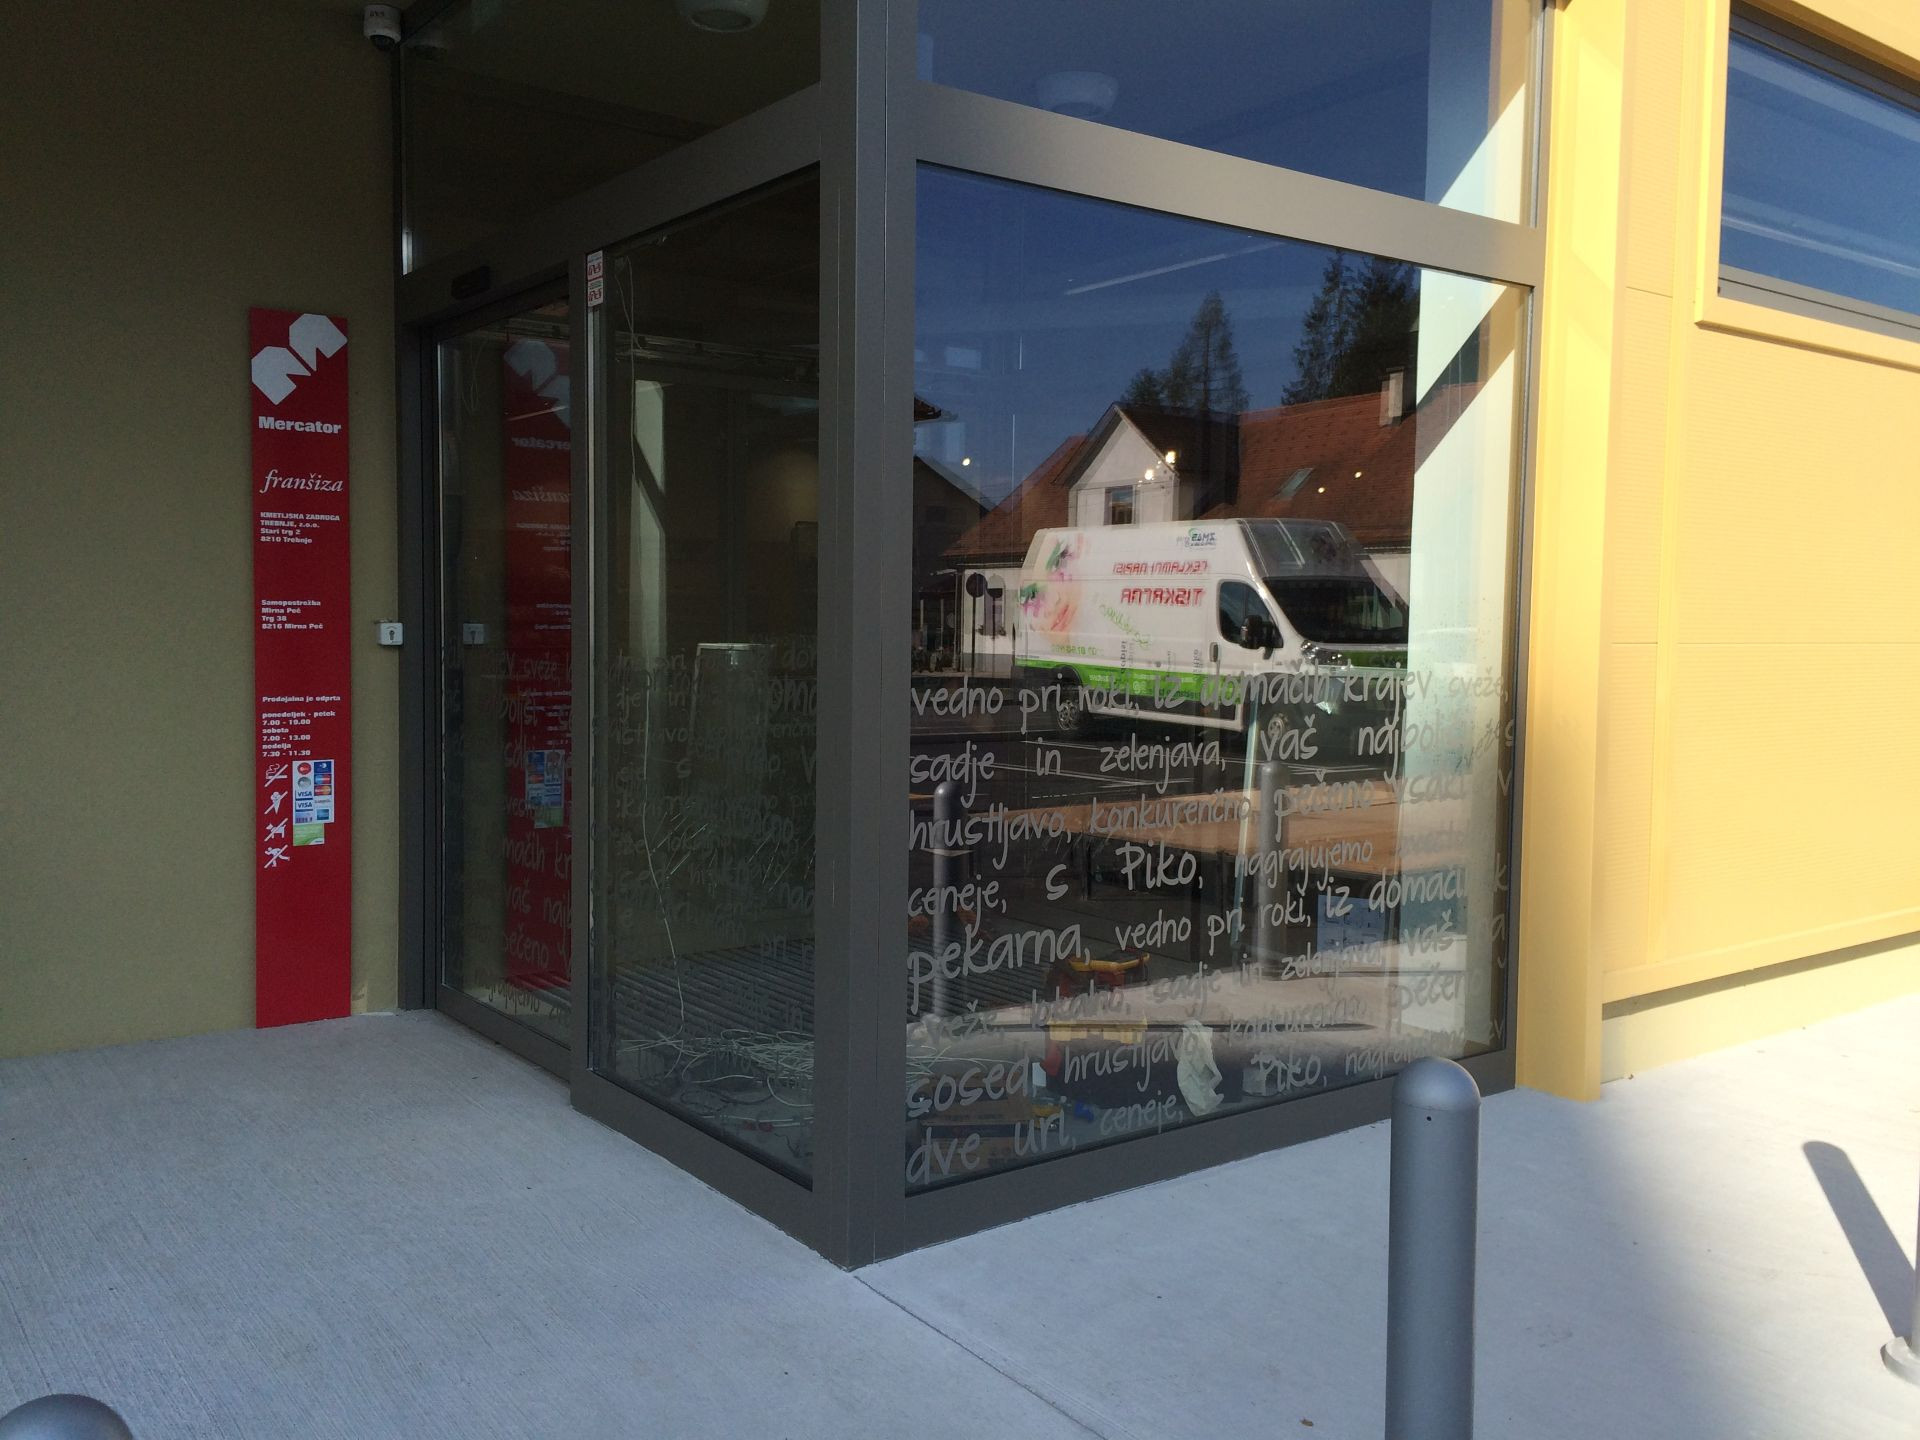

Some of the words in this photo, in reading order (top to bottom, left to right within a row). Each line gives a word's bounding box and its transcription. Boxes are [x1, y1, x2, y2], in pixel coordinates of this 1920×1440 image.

[258, 416, 342, 434] Mercator
[259, 469, 344, 494] franšiza
[281, 529, 294, 537] trg
[283, 537, 313, 545] Trebnje
[305, 514, 341, 522] ZADRUGA
[261, 615, 275, 623] Trg
[911, 675, 1004, 718] vedno
[1018, 673, 1064, 735] pri
[1153, 674, 1187, 709] iz
[288, 749, 311, 757] 11.30
[909, 740, 996, 809] sadje
[1036, 736, 1062, 777] in
[1099, 732, 1227, 794] zelenjava,
[1260, 713, 1319, 762] vaš
[908, 802, 1072, 870] hrustljavo,
[907, 874, 1008, 936] ceneje,
[1045, 863, 1070, 901] s
[1115, 839, 1204, 891] Piko,
[1234, 839, 1374, 891] nagrajujemo
[906, 923, 1091, 1016] pekarna,
[1114, 908, 1192, 952] vedno
[1207, 897, 1246, 956] pri
[1260, 890, 1312, 928] roki,
[1326, 876, 1354, 918] iz
[1240, 953, 1265, 988] in
[1404, 909, 1454, 957] vaš
[907, 1054, 1038, 1119] sosed,
[906, 1126, 981, 1185] dve
[1014, 1095, 1077, 1156] uri,
[1101, 1090, 1184, 1135] ceneje,
